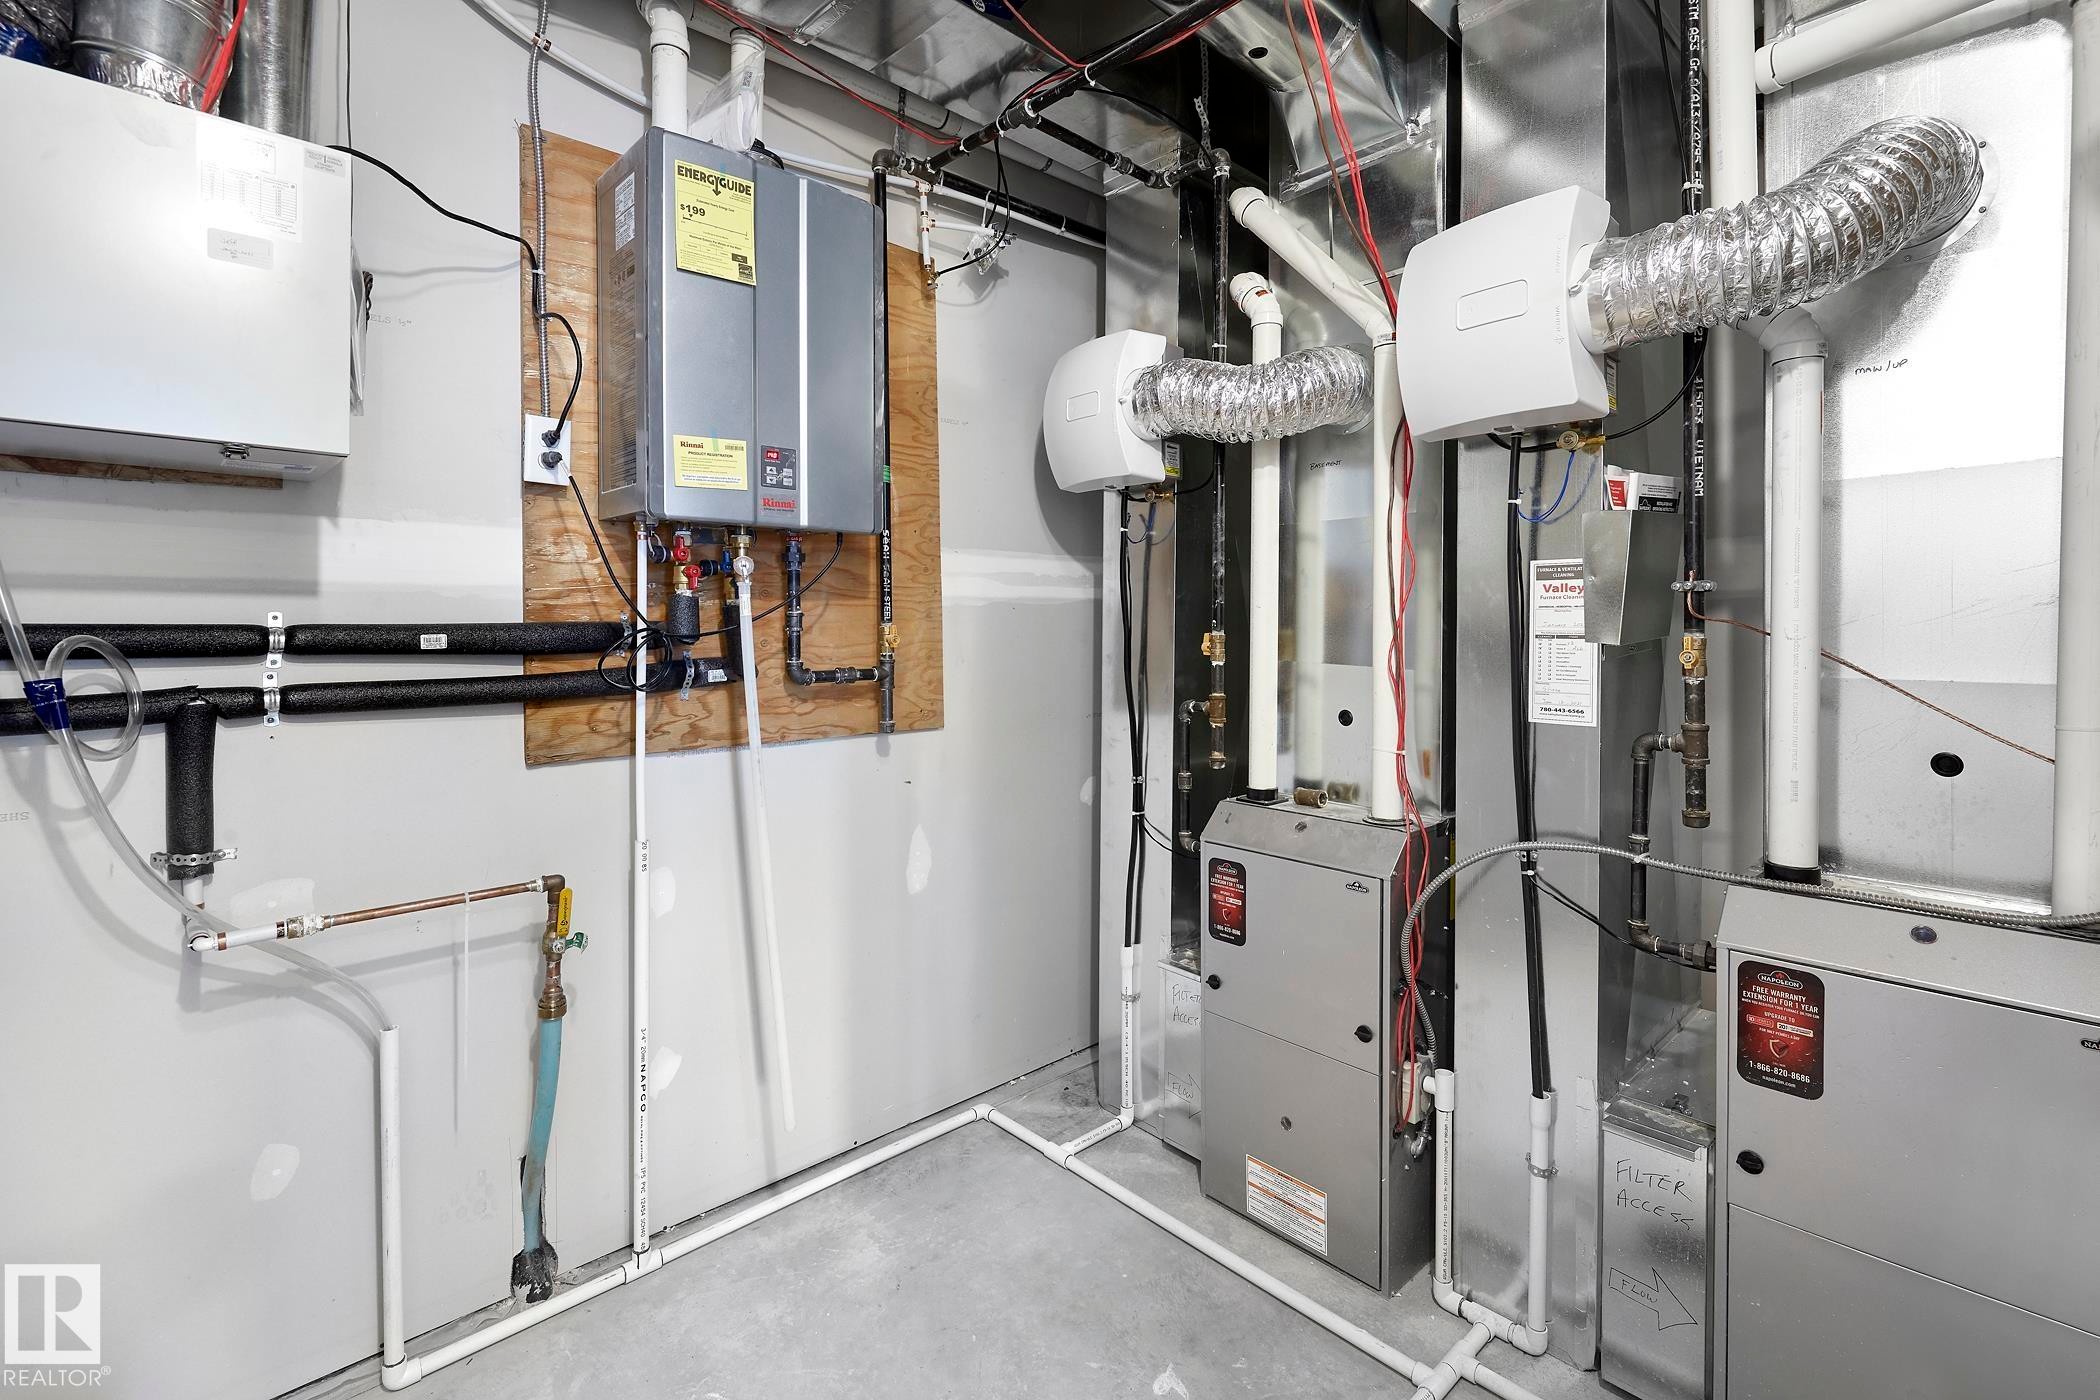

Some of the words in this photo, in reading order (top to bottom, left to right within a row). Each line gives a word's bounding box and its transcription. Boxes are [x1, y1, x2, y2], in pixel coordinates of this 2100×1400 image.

[1690, 27, 1700, 51] A53
[677, 165, 752, 196] ENERGYGUIDE
[680, 204, 706, 216] $199
[680, 440, 704, 449] Rinnai
[1694, 440, 1704, 497] VIETNAM
[762, 498, 796, 508] Rinnai
[1543, 583, 1584, 595] Valley
[1761, 975, 1800, 988] NAPOLEON
[1743, 990, 1778, 1004] EXTENSION
[1780, 999, 1793, 1007] FOR
[1801, 1004, 1819, 1013] YEAR
[1752, 985, 1768, 994] FREE
[1770, 989, 1806, 1002] WARRANTY
[1173, 1006, 1201, 1026] ACCES
[1764, 1012, 1787, 1021] UPGRADE
[1749, 1060, 1810, 1083] 1-866-820-8686
[1762, 1076, 1796, 1088] napoleon.com
[1616, 1158, 1692, 1202] FILTER
[1617, 1188, 1694, 1231] ACCESS
[1621, 1278, 1658, 1303] FLOW
